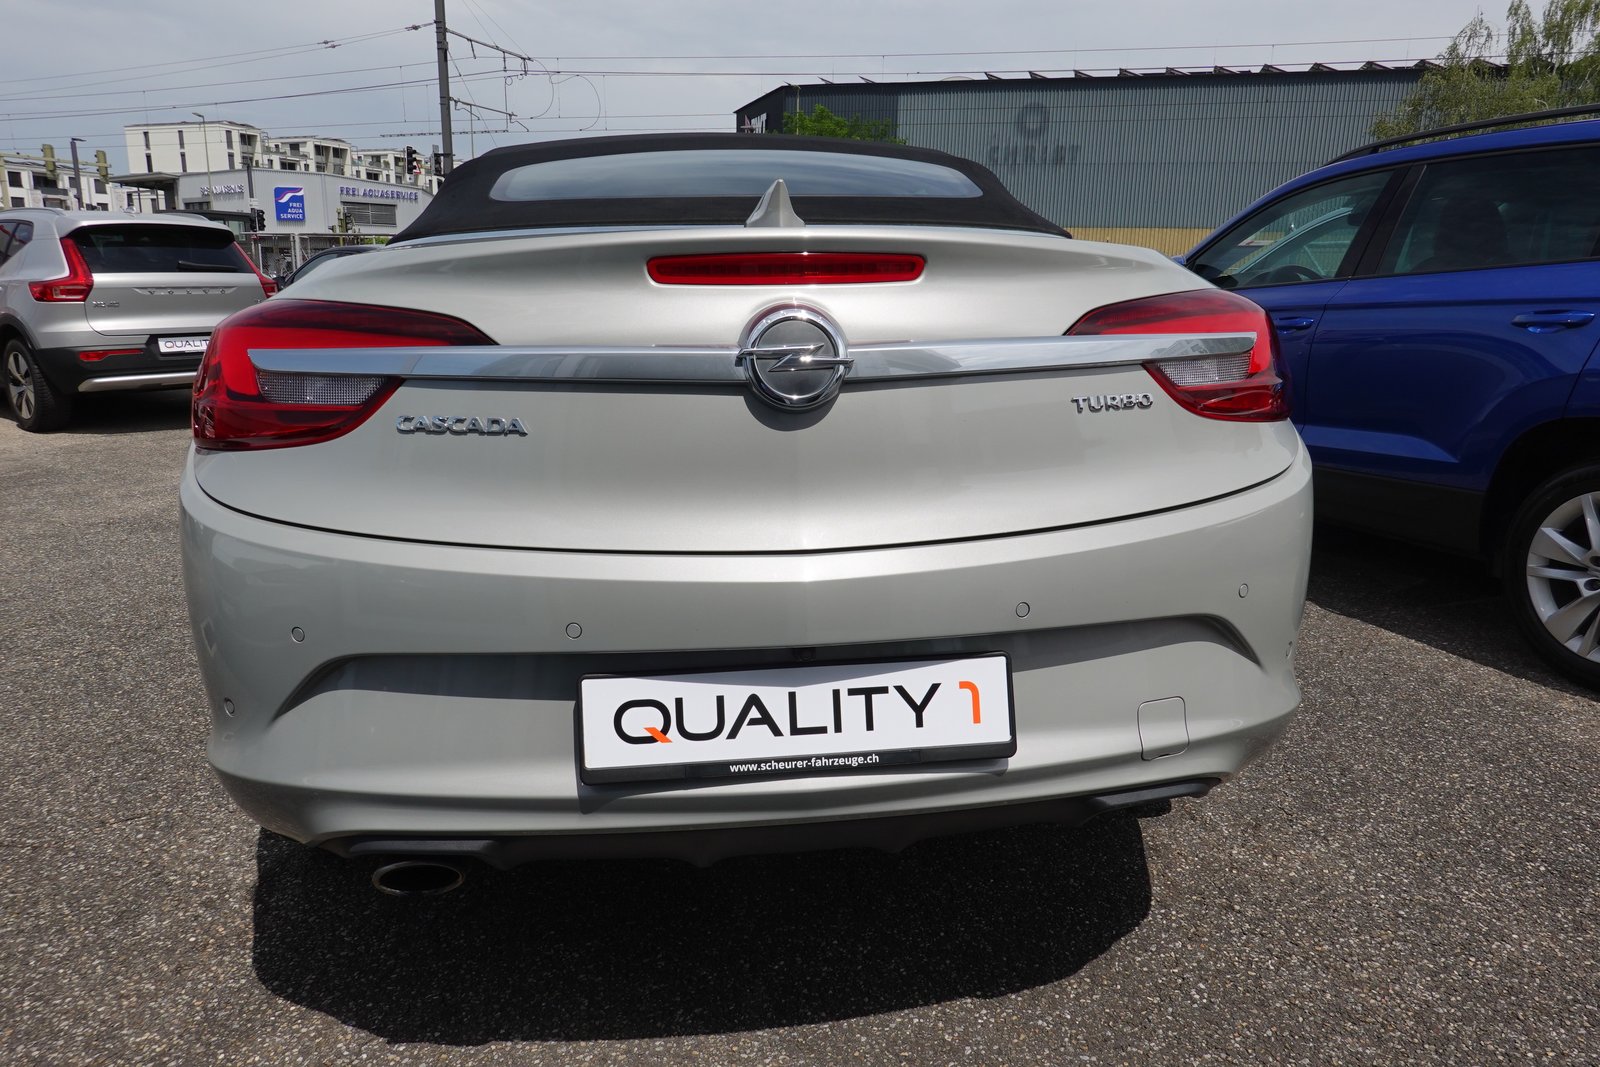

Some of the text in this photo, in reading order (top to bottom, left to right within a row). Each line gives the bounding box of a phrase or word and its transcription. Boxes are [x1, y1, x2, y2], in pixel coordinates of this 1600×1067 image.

[339, 186, 419, 201] FREI AQUASERVICE
[147, 287, 226, 295] VOLVO
[164, 338, 210, 349] QUALIT
[1071, 393, 1153, 414] TURBO
[396, 415, 528, 437] CASCADA
[613, 680, 982, 745] QUALITY 1
[729, 753, 880, 773] www.scheurer-fahrzeuge.ch
